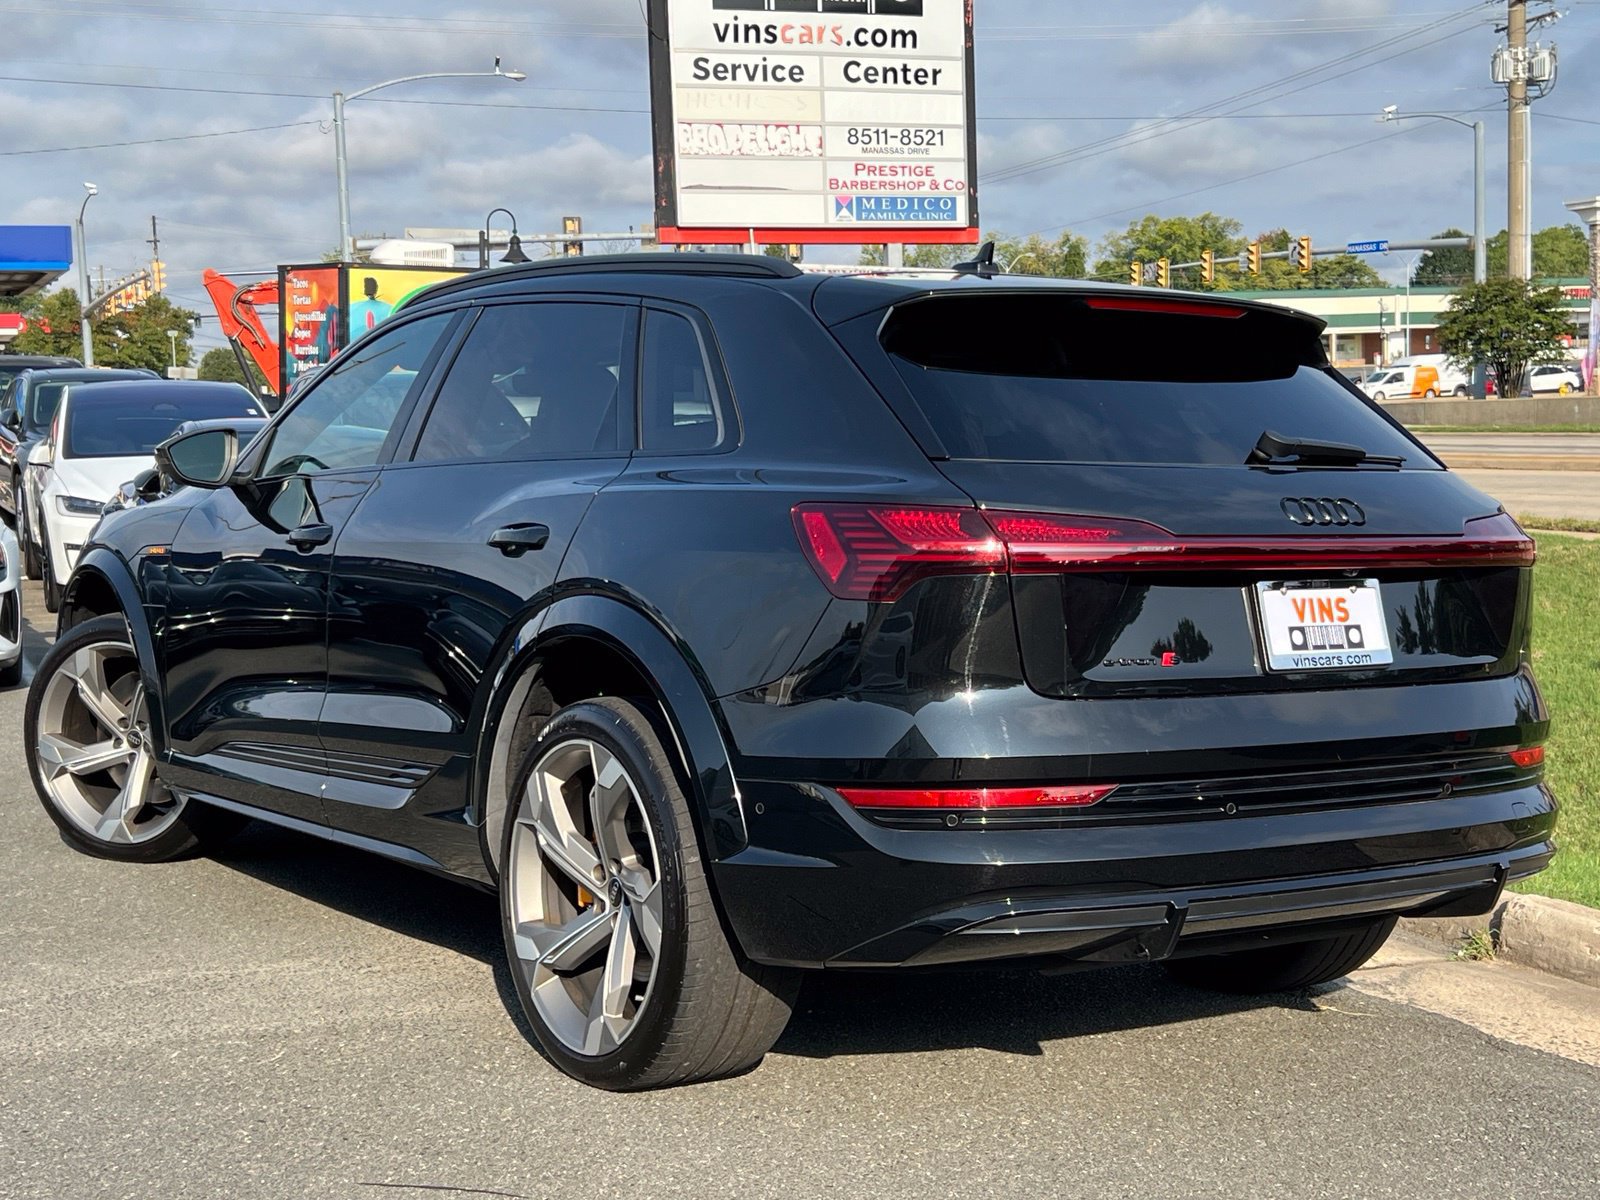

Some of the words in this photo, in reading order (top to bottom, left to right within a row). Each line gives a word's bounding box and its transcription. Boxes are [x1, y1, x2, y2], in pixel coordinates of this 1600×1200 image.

[713, 16, 918, 49] vinscars.com
[692, 57, 805, 83] Service
[843, 60, 942, 85] Center
[847, 127, 945, 146] 8511-8521
[861, 147, 905, 155] MANASSAS
[907, 147, 930, 155] DRIVE
[854, 163, 935, 176] PRESTIGE
[829, 178, 926, 190] BARBERSHOP
[861, 198, 952, 210] MEDICO
[861, 212, 908, 220] FAMILY
[910, 212, 952, 220] CLINIC
[293, 278, 308, 288] Tacos
[293, 295, 311, 304] Tortas
[295, 311, 326, 323] Quesadillas
[294, 327, 311, 340] Sopes
[295, 343, 319, 355] Burritos
[1291, 597, 1350, 623] VINS
[1292, 653, 1372, 667] vinscars.com
